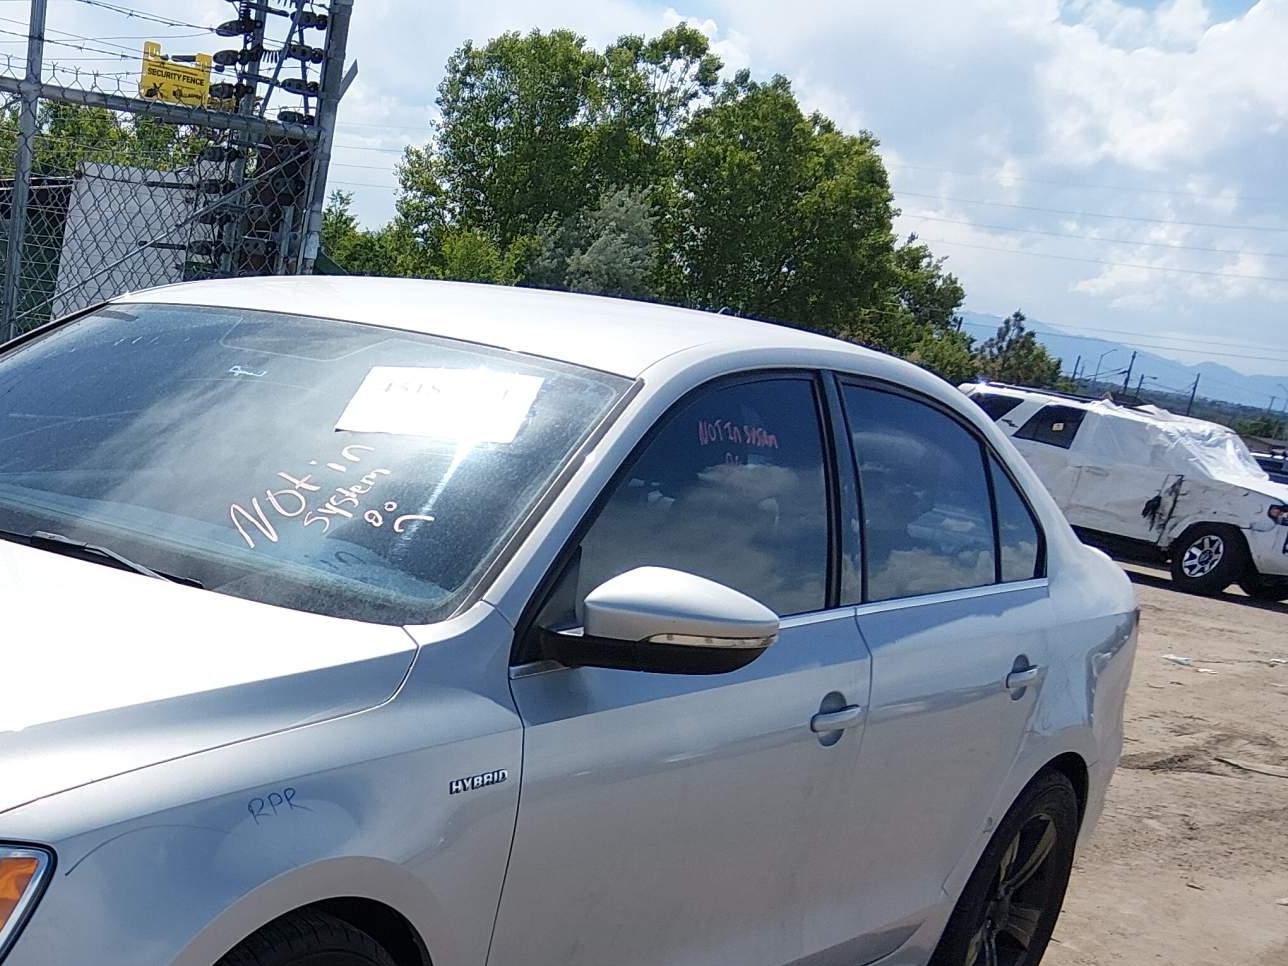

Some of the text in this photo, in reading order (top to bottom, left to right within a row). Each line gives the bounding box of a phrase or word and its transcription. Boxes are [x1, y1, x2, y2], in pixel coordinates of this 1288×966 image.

[147, 67, 205, 87] SECURITY FENCE
[698, 418, 723, 446] NOT
[449, 768, 509, 795] HYBRID
[247, 787, 317, 825] RPR
